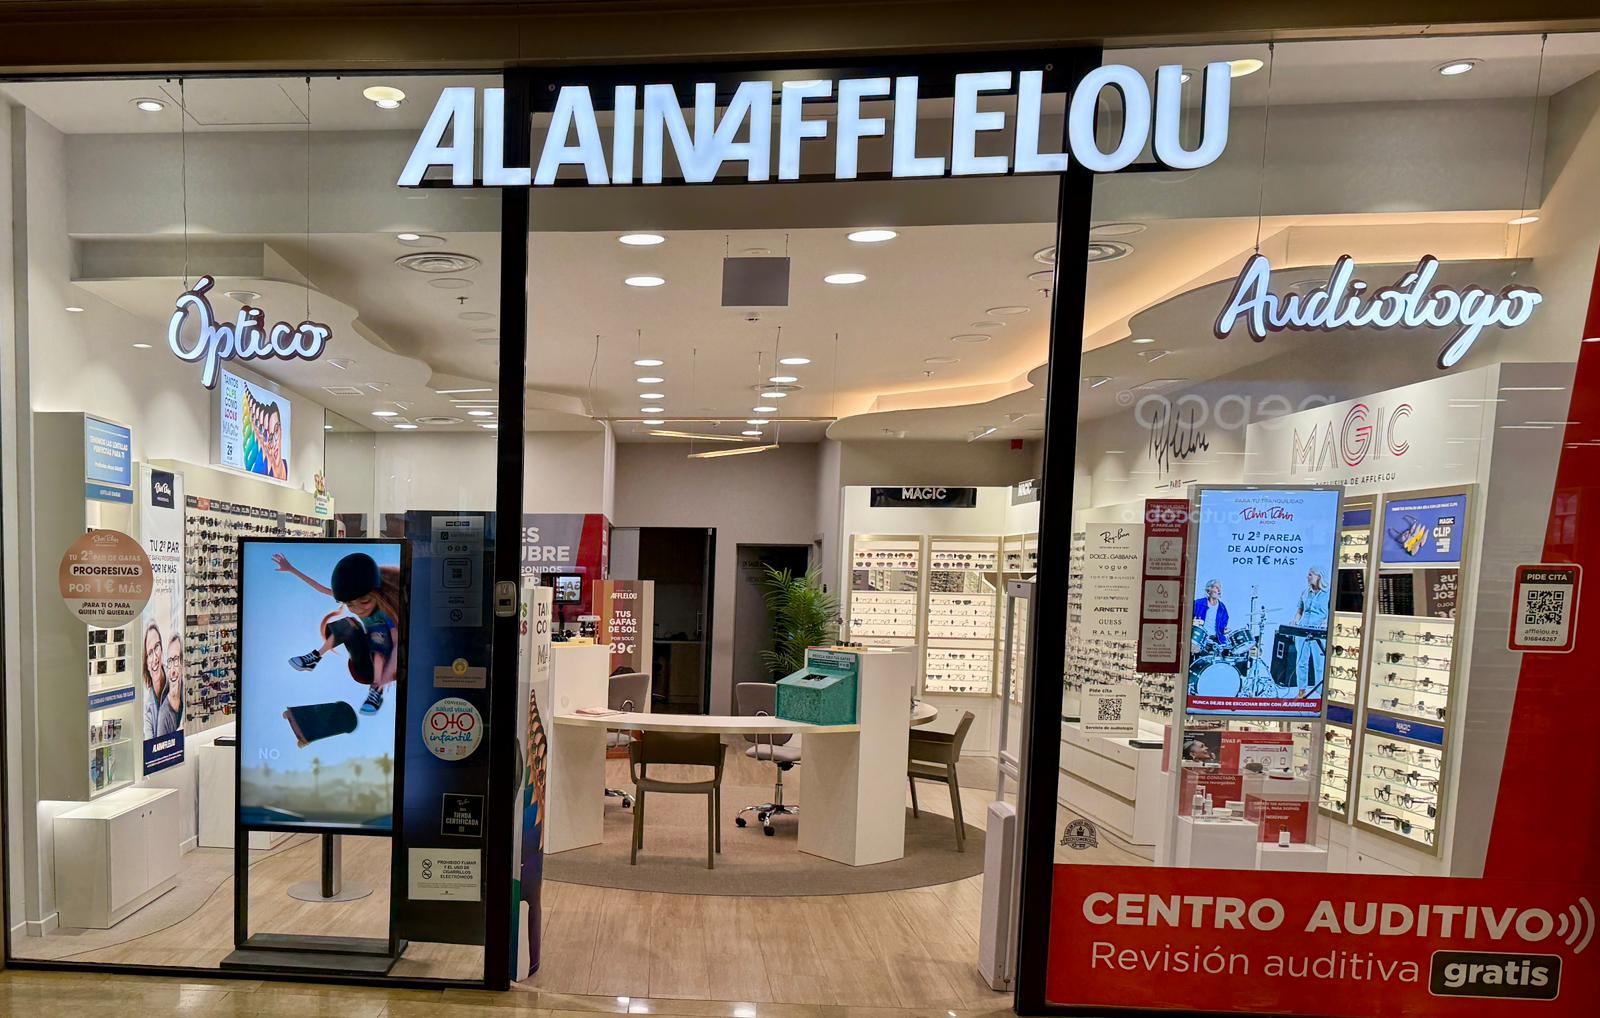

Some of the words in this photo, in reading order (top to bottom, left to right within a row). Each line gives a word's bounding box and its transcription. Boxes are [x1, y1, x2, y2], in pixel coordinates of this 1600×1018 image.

[1214, 254, 1543, 369] Audiólogo
[168, 275, 332, 389] Óptico
[1290, 403, 1413, 475] MAGIC
[902, 488, 947, 500] MAGIC
[1099, 528, 1130, 543] Ray-Ban
[1232, 533, 1245, 541] TU
[1247, 531, 1261, 541] 2ª
[1263, 533, 1302, 542] PAREJA
[1433, 526, 1451, 538] CLIP
[150, 539, 158, 551] TU
[167, 541, 180, 553] PAR
[1227, 545, 1241, 553] DE
[1243, 544, 1304, 553] AUDÍFONOS
[1232, 557, 1254, 565] POR
[1256, 555, 1271, 565] 1€
[73, 566, 140, 576] PROGRESIVAS
[167, 562, 177, 573] MÁS
[1527, 573, 1547, 581] PIDE
[1548, 573, 1568, 581] CITA
[69, 583, 91, 593] POR
[118, 581, 143, 593] MÁS
[615, 610, 632, 618] TUS
[609, 618, 637, 626] GAFAS
[608, 625, 620, 633] DE
[620, 625, 638, 633] SOL
[429, 730, 473, 744] infantil
[258, 748, 280, 760] NO
[445, 818, 479, 826] CERTIFICADA
[1082, 891, 1285, 931] CENTRO
[1304, 900, 1554, 941] AUDITIVO
[1091, 941, 1249, 975] Revisión
[1263, 950, 1420, 982] auditiva
[1443, 960, 1549, 988] gratis
